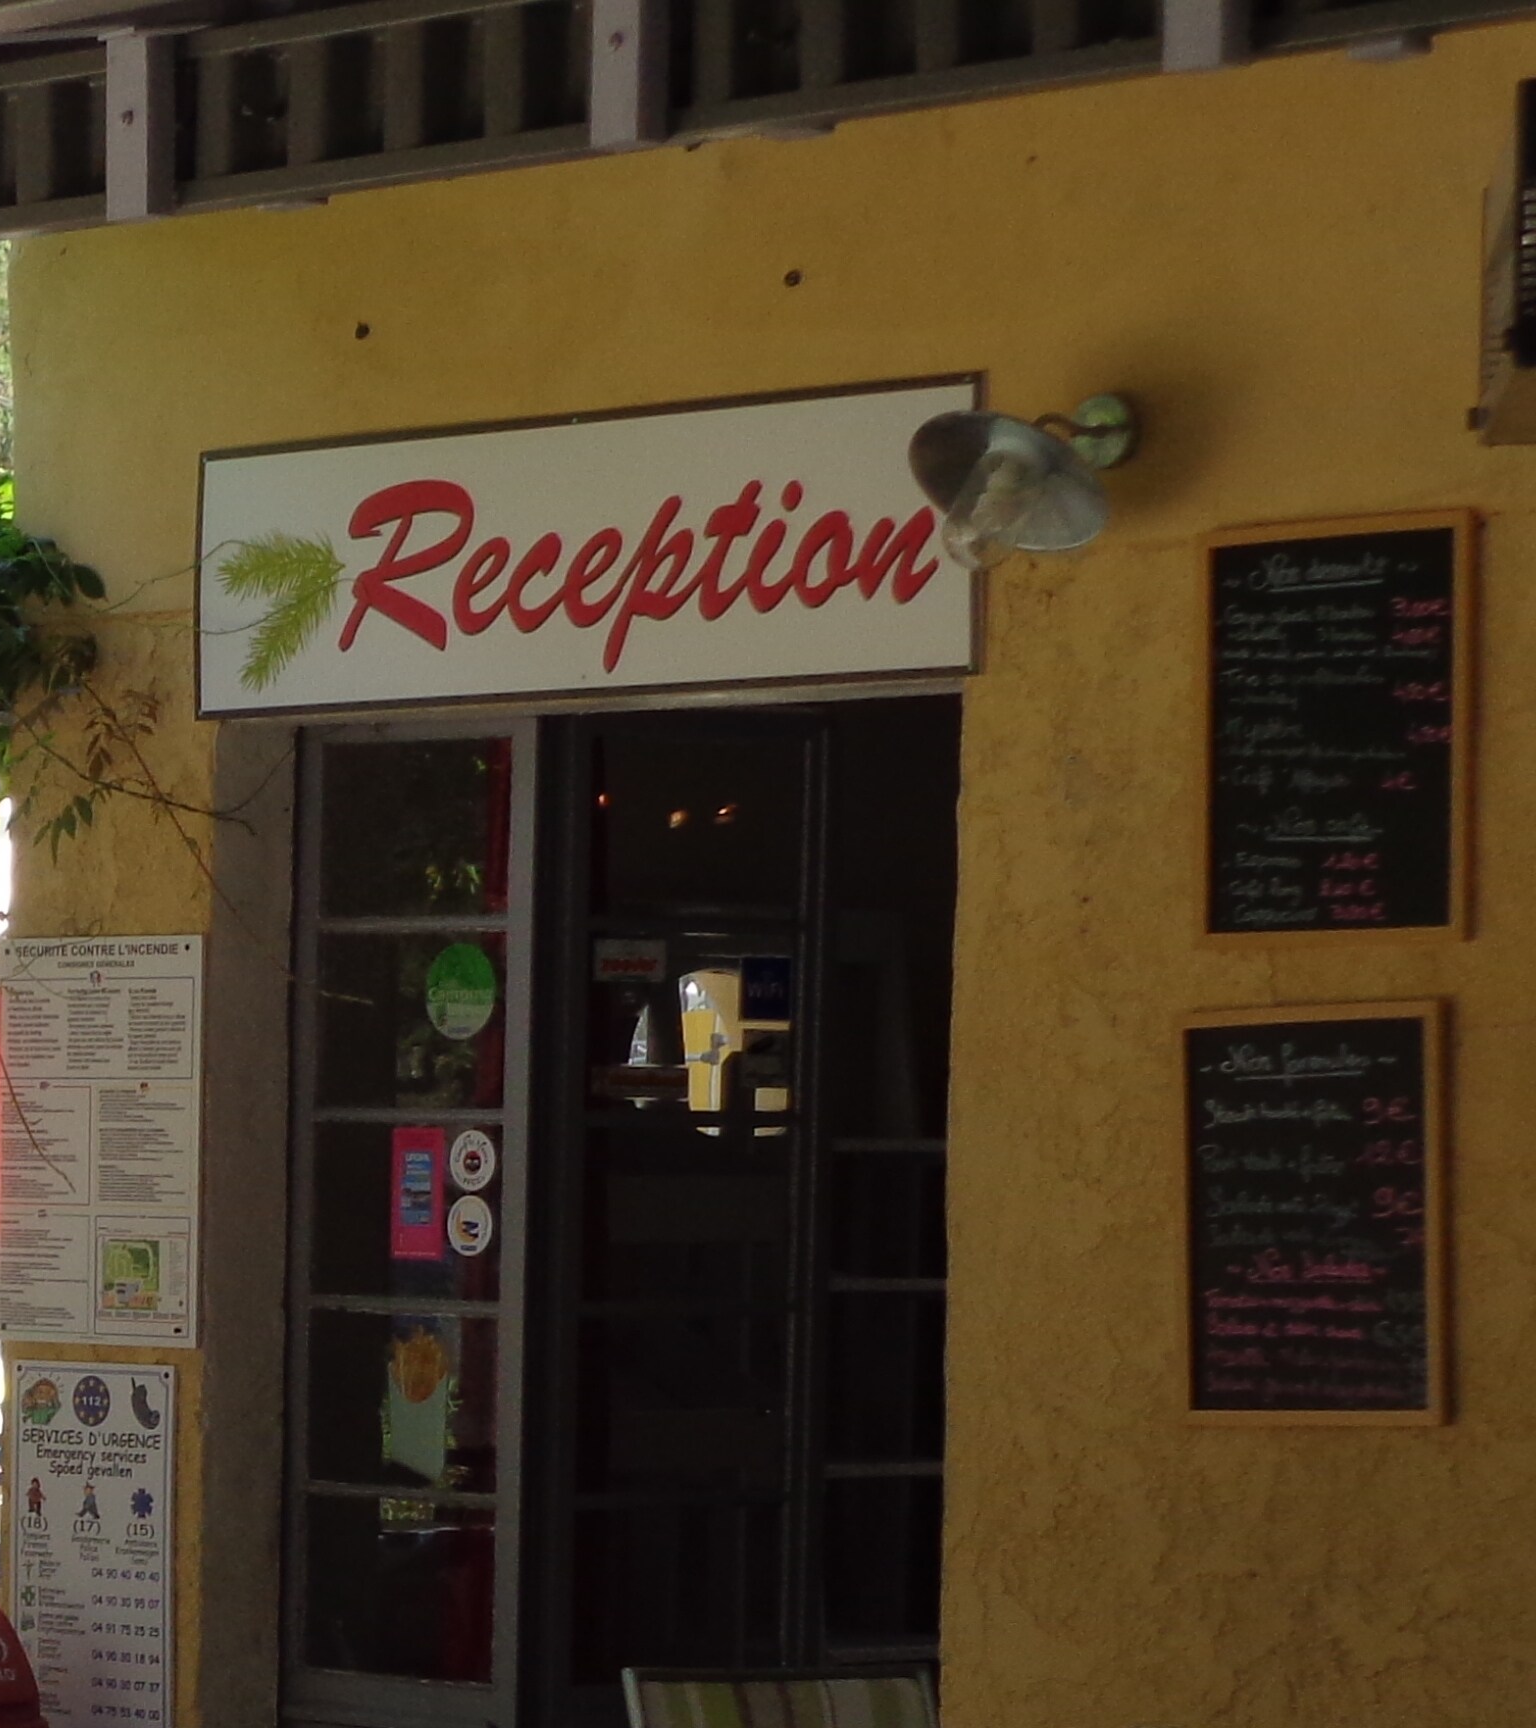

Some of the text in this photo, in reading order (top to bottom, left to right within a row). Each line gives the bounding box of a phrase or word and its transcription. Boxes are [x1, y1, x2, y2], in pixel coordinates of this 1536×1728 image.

[338, 478, 939, 673] Reception
[71, 944, 115, 956] CONTRE
[118, 942, 179, 956] L'INCENDIE
[81, 1396, 102, 1406] 112
[22, 1428, 161, 1450] SERVICES D'URGENCE
[36, 1444, 147, 1464] Emergency services
[49, 1461, 133, 1480] Spoed gevallen
[20, 1516, 48, 1531] (18)
[73, 1519, 101, 1535] (17)
[126, 1523, 155, 1539] (15)
[91, 1567, 103, 1577] 04
[91, 1622, 103, 1632] 04
